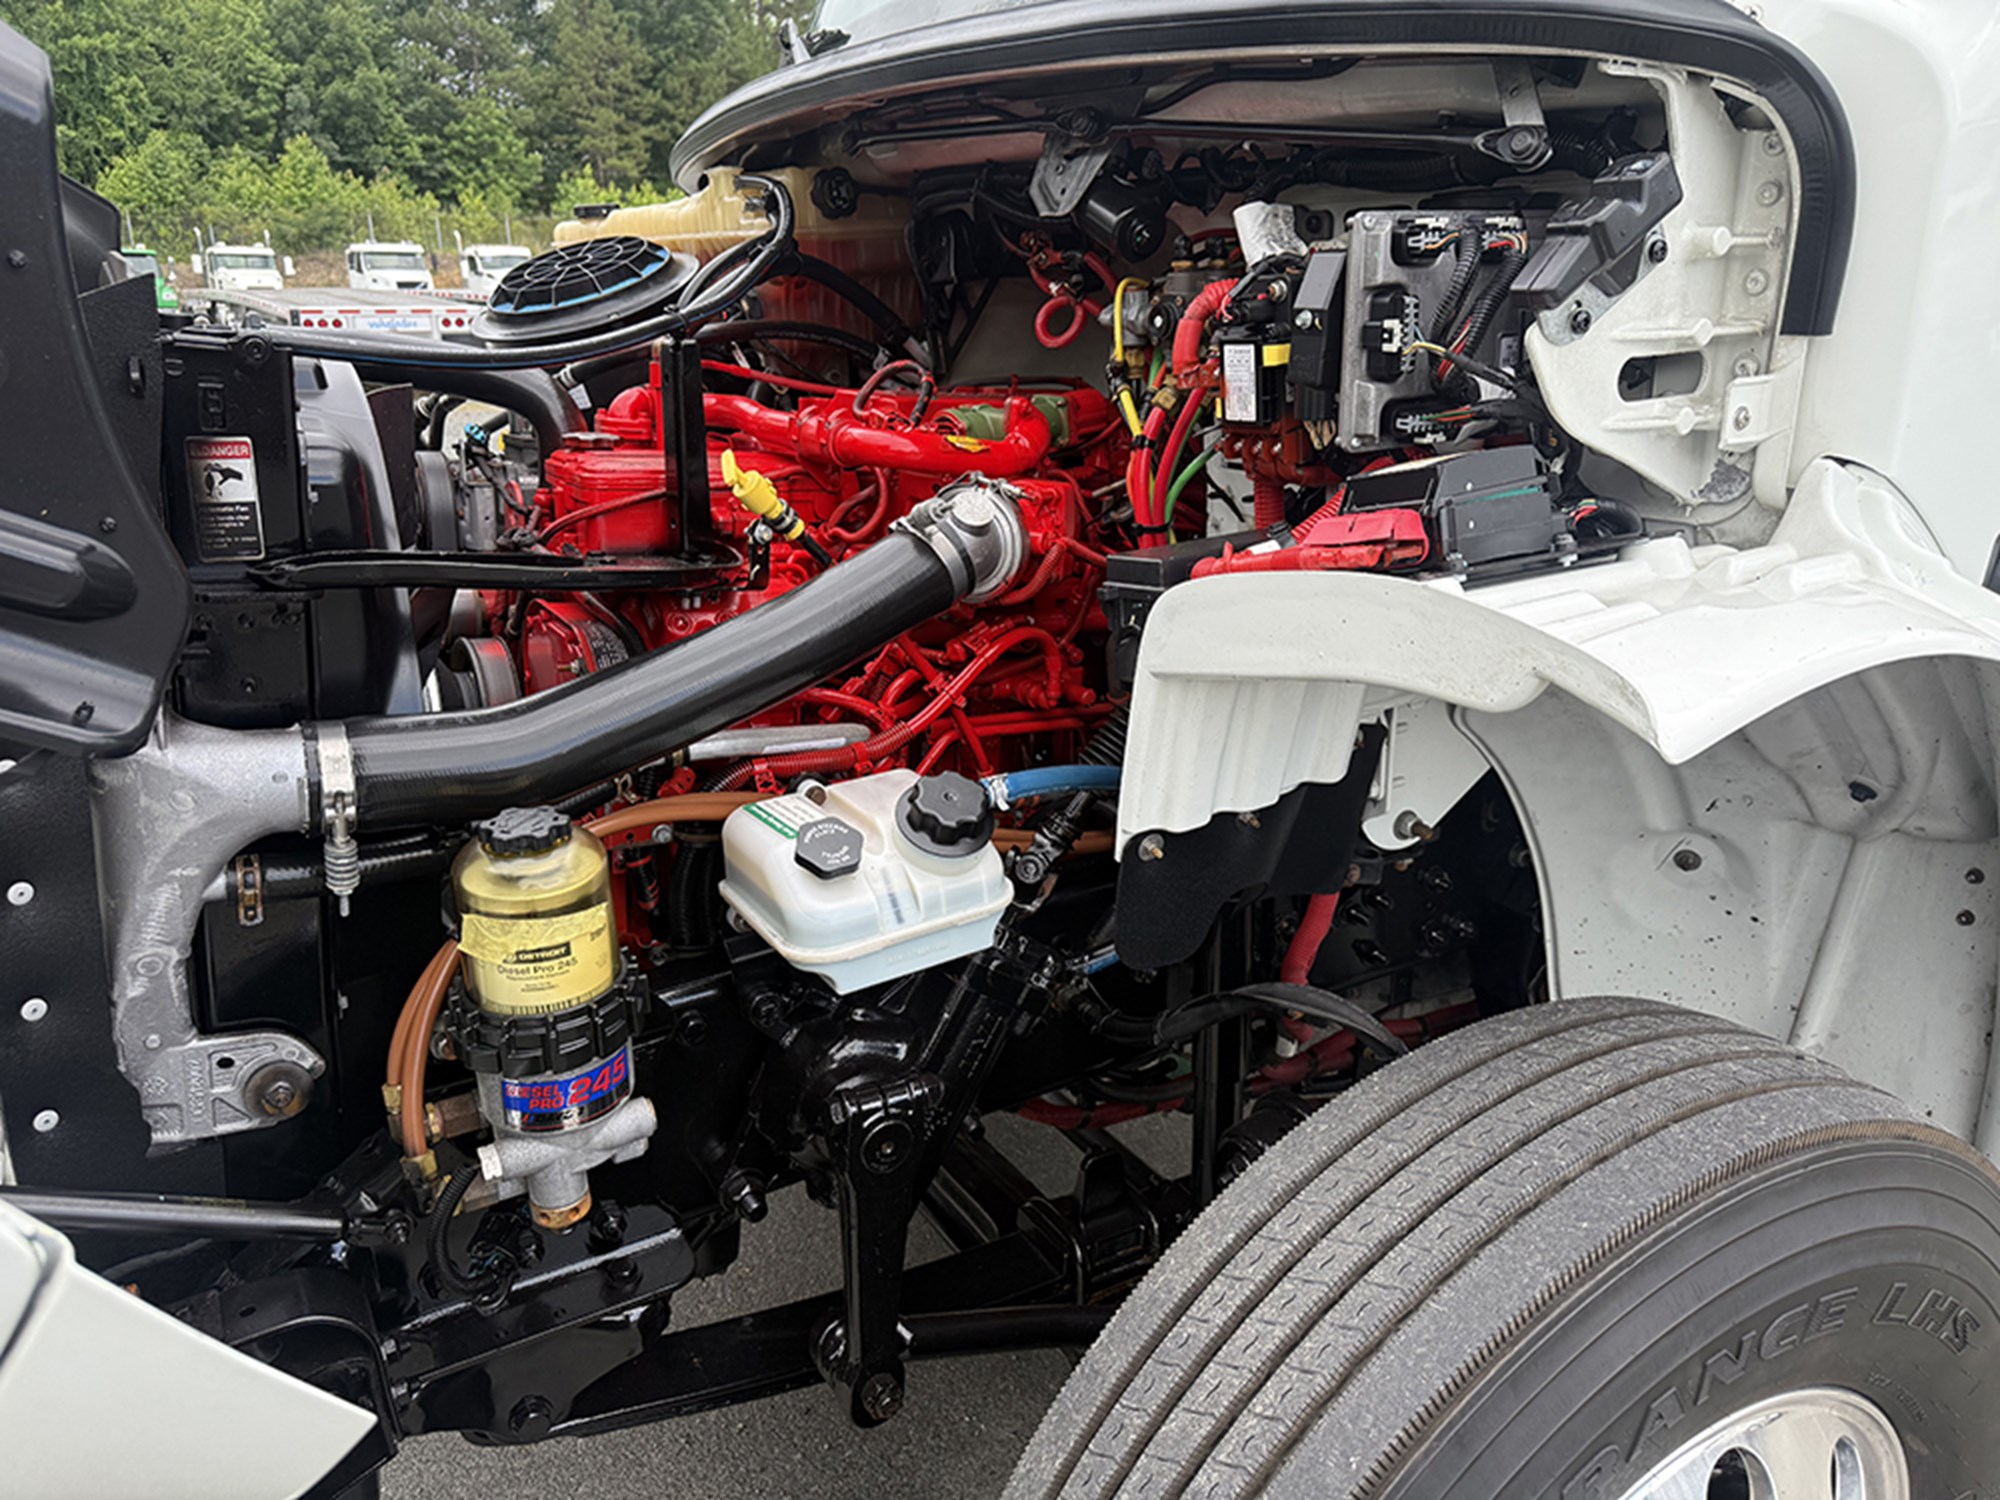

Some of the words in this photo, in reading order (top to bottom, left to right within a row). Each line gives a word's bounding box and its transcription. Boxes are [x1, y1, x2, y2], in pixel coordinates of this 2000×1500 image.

[201, 444, 249, 457] DANGER
[518, 946, 568, 961] DETROIT
[497, 964, 531, 976] Diesel
[533, 964, 554, 974] Pro
[557, 957, 579, 971] 245
[505, 1083, 563, 1099] DIESEL
[568, 1053, 626, 1106] 245
[528, 1097, 565, 1111] PRO
[1871, 1282, 1981, 1356] LHS
